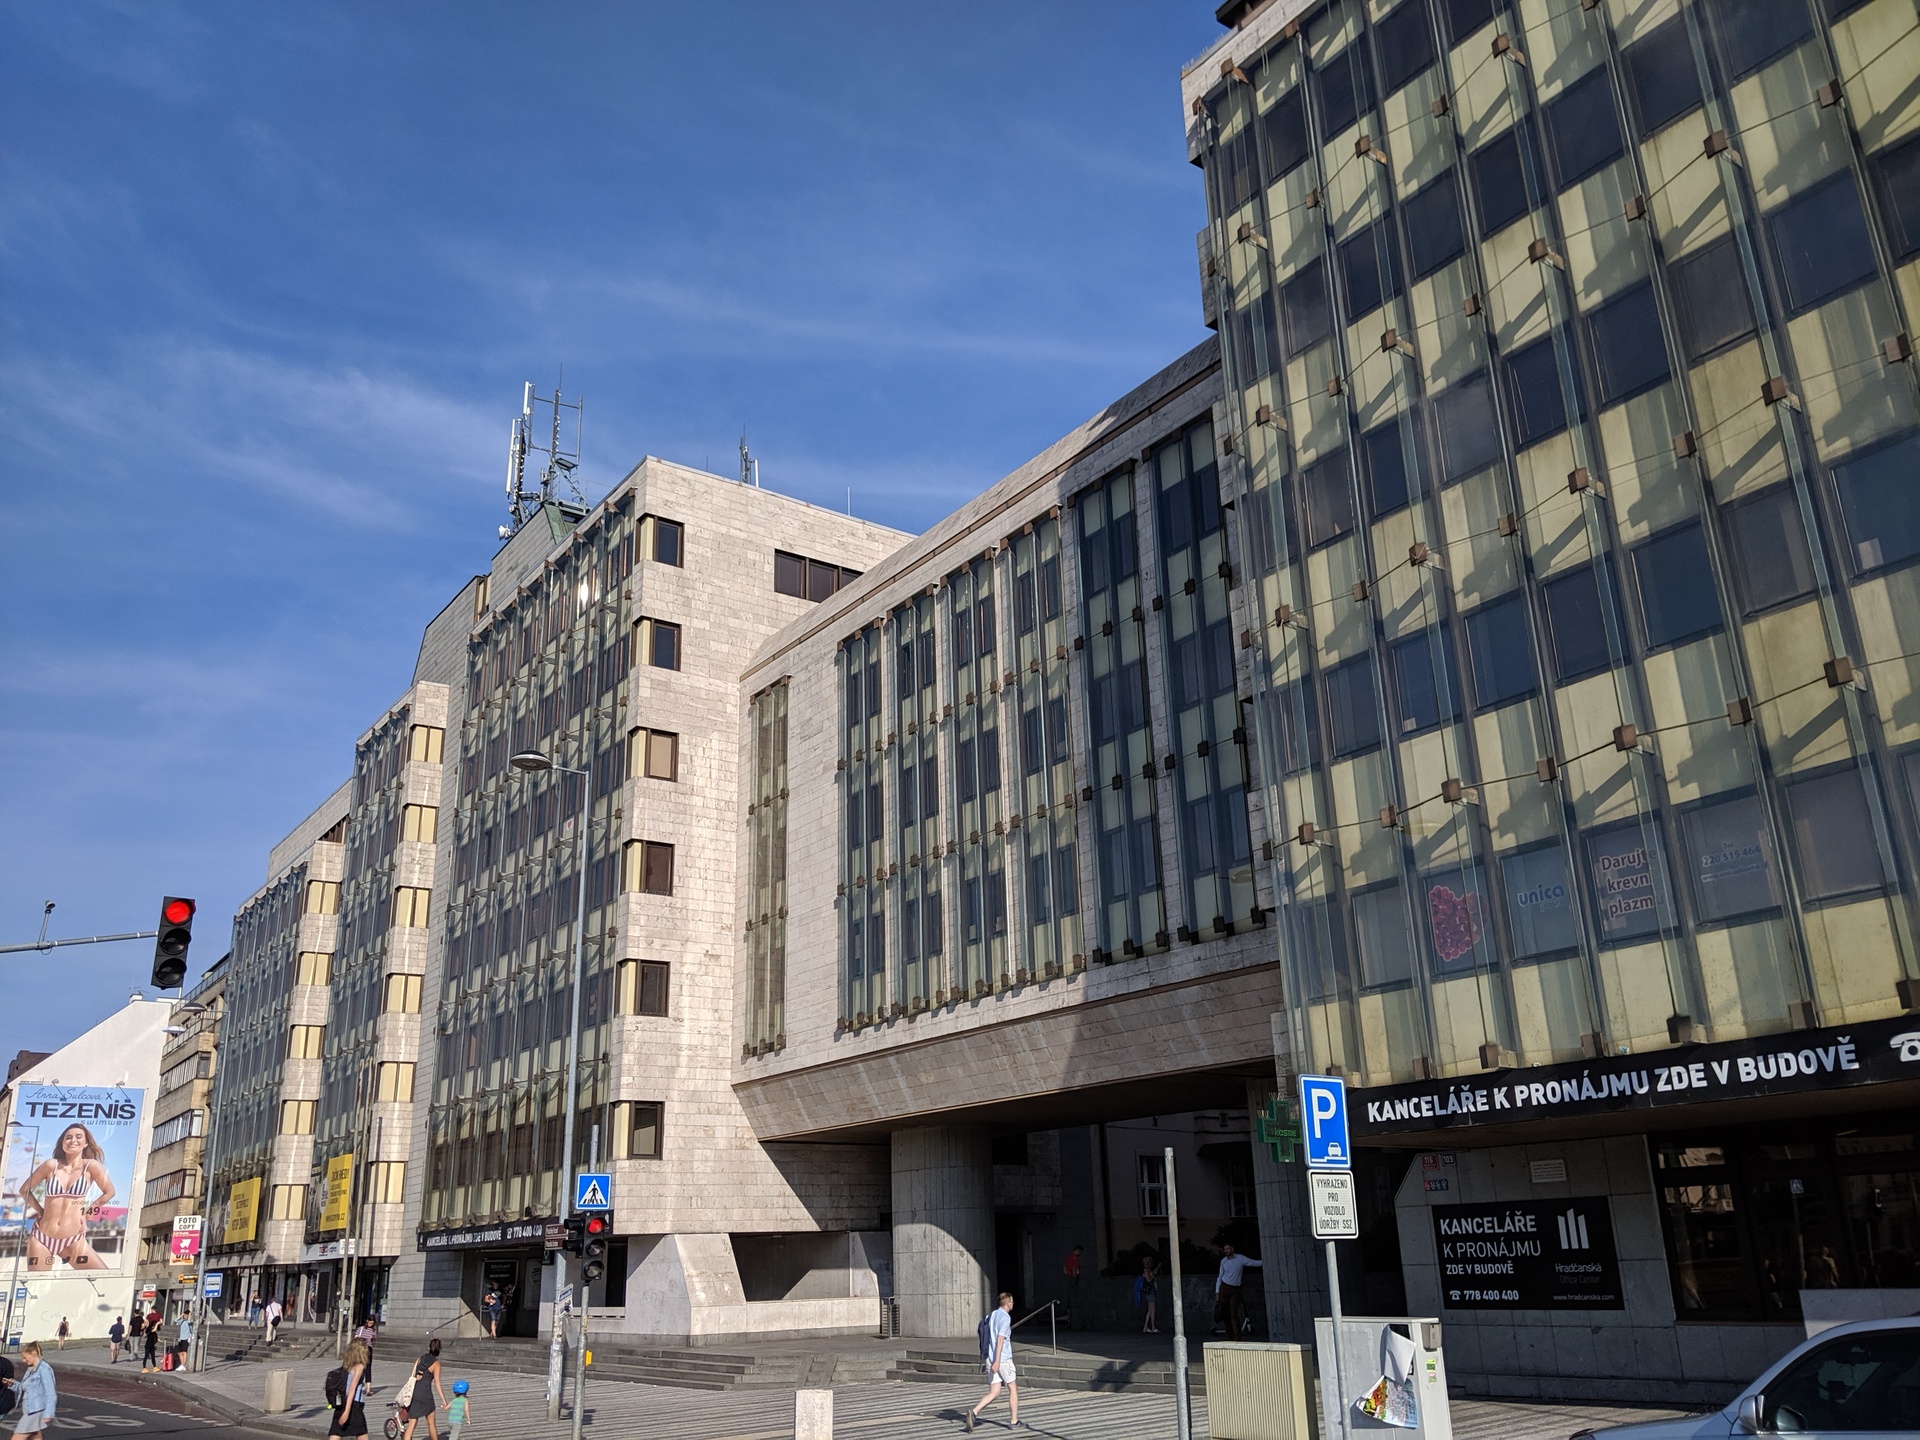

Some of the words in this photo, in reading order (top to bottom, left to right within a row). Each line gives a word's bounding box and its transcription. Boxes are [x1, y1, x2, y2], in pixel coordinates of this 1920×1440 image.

[1702, 854, 1721, 867] 220
[1723, 850, 1741, 862] 515
[1742, 845, 1761, 857] 464
[1606, 872, 1652, 894] krevn
[1518, 883, 1565, 906] unica
[1367, 1084, 1490, 1123] KANCELÁŘE
[1493, 1086, 1512, 1110] K
[1514, 1069, 1650, 1108] PRONÁJMU
[1654, 1062, 1708, 1092] ZDE
[1710, 1059, 1730, 1085] V
[1737, 1035, 1860, 1083] BUDOVĚ
[25, 1100, 136, 1119] TEZENIS
[1310, 1088, 1337, 1139] P
[80, 1119, 134, 1127] swimwear
[1316, 1178, 1348, 1189] VYHRAZENO
[1327, 1192, 1339, 1202] PRO
[80, 1206, 100, 1216] 149
[1323, 1205, 1345, 1216] VOZIDLO
[178, 1216, 197, 1224] FOTO
[1319, 1218, 1340, 1230] ÚDRŽBY
[1342, 1219, 1353, 1230] SSZ
[1440, 1210, 1537, 1235] KANCELÁŘE
[1443, 1243, 1454, 1258] K
[1456, 1237, 1541, 1258] PRONÁJMU
[1446, 1264, 1465, 1275] ZDE
[1465, 1263, 1473, 1275] V
[1474, 1260, 1515, 1275] BUDOVĚ
[1555, 1262, 1602, 1273] Hradčanská
[1463, 1290, 1481, 1300] 778
[1482, 1290, 1500, 1300] 400
[1501, 1290, 1520, 1300] 400
